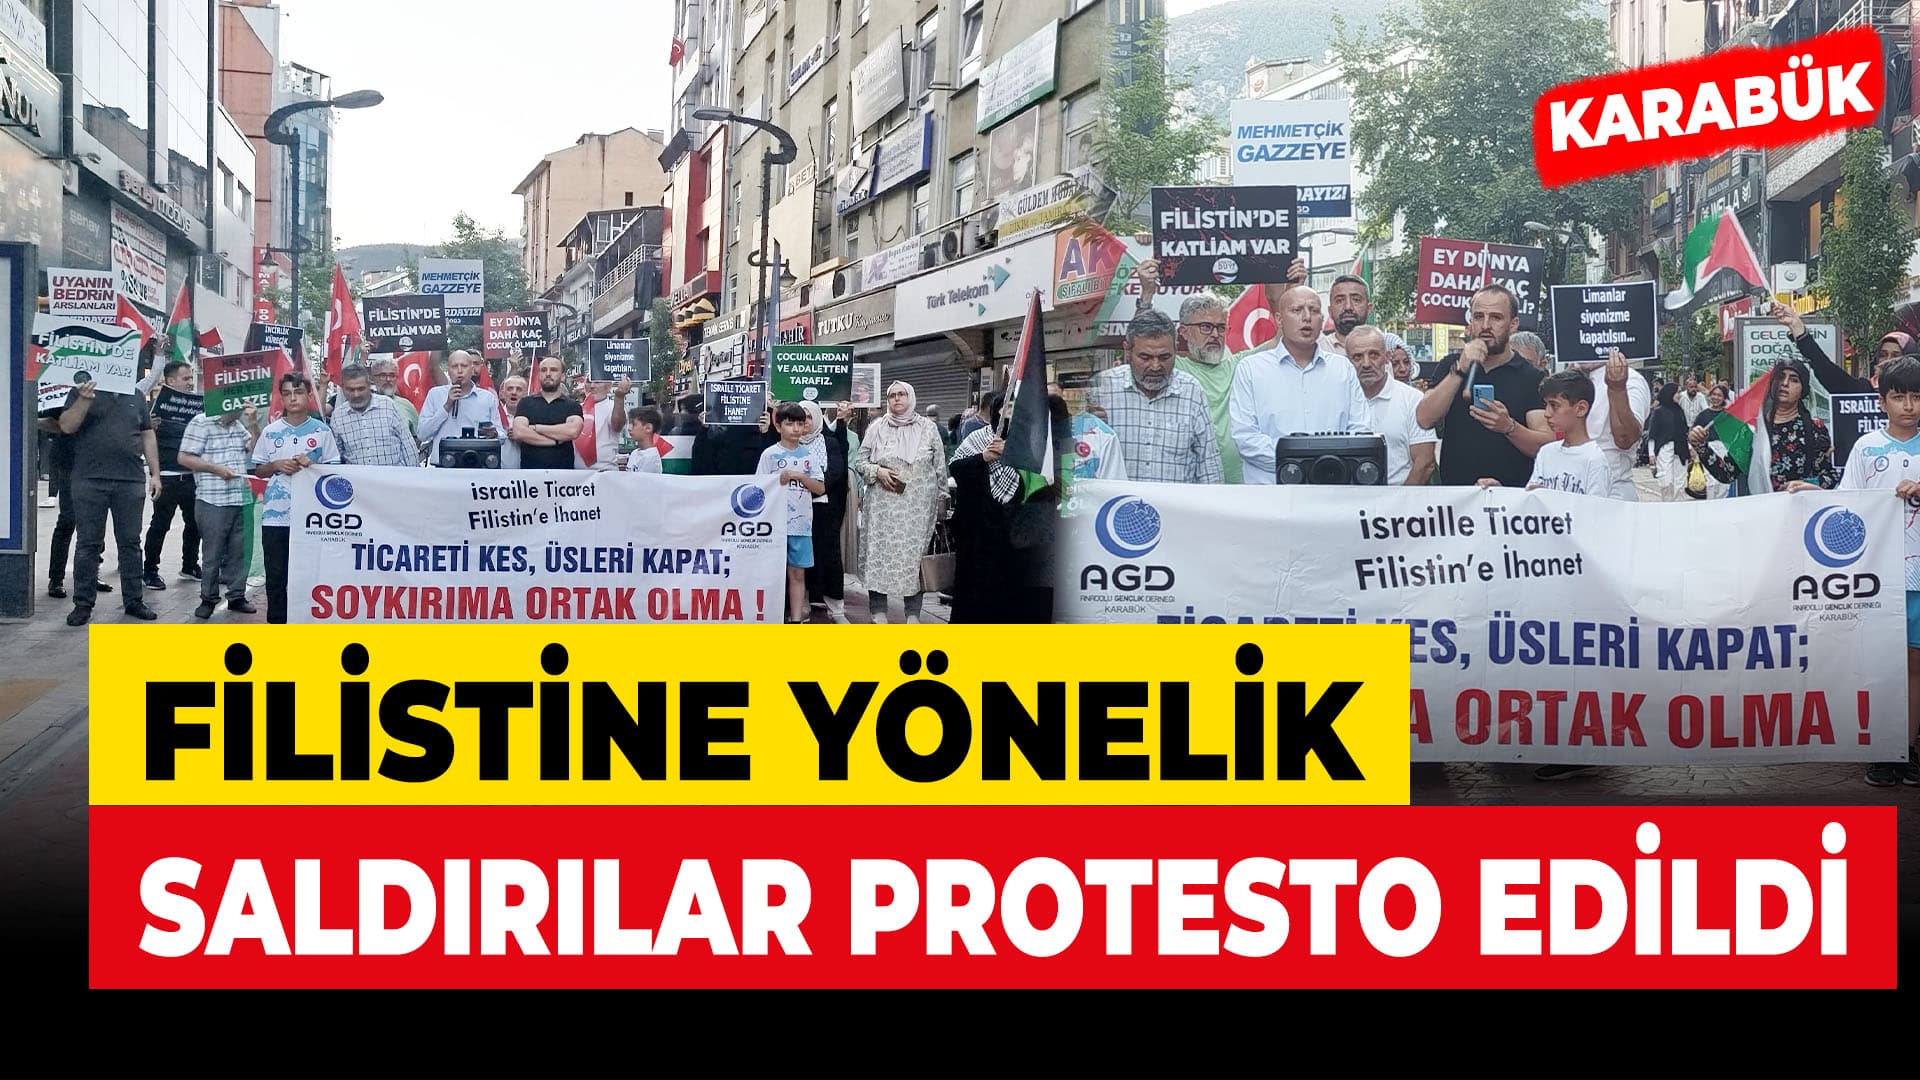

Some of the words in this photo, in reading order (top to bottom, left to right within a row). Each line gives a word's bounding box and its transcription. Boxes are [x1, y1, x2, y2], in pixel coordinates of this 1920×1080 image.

[1237, 119, 1344, 141] MEHMETÇİK
[1236, 141, 1347, 163] GAZZEYE
[1161, 206, 1290, 231] FİLİSTİN'DE
[1161, 236, 1250, 257] KATLİAM
[1250, 239, 1290, 255] VAR
[1433, 248, 1455, 265] EY
[52, 276, 113, 288] UYANIN
[421, 272, 480, 282] MEHMETÇİK
[1430, 271, 1483, 292] DAHA
[421, 283, 482, 294] GAZZEYE
[926, 293, 946, 310] Türk
[948, 282, 990, 303] Telekom
[1583, 288, 1627, 304] Limanlar
[53, 301, 116, 310] ARSLANLARI
[1421, 292, 1472, 309] ÇOCUK
[368, 307, 441, 322] FİLİSTİN'DE
[490, 317, 503, 327] EY
[506, 316, 542, 327] DÜNYA
[1580, 309, 1630, 326] siyonizme
[369, 325, 420, 337] KATLİAM
[421, 325, 442, 335] VAR
[817, 312, 855, 337] TUTKU
[489, 329, 518, 340] DAHA
[521, 329, 543, 341] KAÇ
[1579, 328, 1636, 347] kapatılsın...
[38, 332, 135, 361] FİLİSTİN'DE
[486, 340, 513, 350] ÇOCUK
[36, 352, 100, 373] KATLİAM
[104, 363, 133, 378] VAR
[777, 351, 849, 363] ÇOCUKLARDAN
[214, 365, 272, 386] FİLİSTİN
[777, 364, 789, 373] VE
[791, 363, 848, 374] ADALETTEN
[735, 382, 760, 393] TİCARET
[790, 375, 832, 386] TARAFIZ.
[222, 393, 268, 412] GAZZE
[470, 480, 539, 500] israille
[544, 480, 595, 498] Ticaret
[306, 512, 363, 529] AGD
[468, 508, 549, 530] Filistin'e
[554, 502, 601, 523] İhanet
[1359, 505, 1475, 539] israille
[1483, 505, 1572, 536] Ticaret
[721, 521, 773, 537] AGD
[351, 537, 469, 572] TİCARETİ
[479, 545, 536, 576] KES,
[545, 540, 633, 574] ÜSLERİ
[643, 548, 731, 578] KAPAT;
[1354, 553, 1494, 590] Filistin'e
[1503, 544, 1583, 579] İhanet
[1080, 563, 1175, 591] AGD
[1793, 573, 1881, 600] AGD
[311, 584, 514, 620] SOYKIRIMA
[526, 586, 636, 620] ORTAK
[647, 587, 744, 621] OLMA
[1104, 604, 1147, 613] KARABÜK
[1819, 613, 1859, 621] KARABÜK
[1489, 611, 1639, 669] ÜSLERİ
[1657, 624, 1808, 673] KAPAT;
[1455, 688, 1648, 747] ORTAK
[1668, 691, 1836, 749] OLMA
